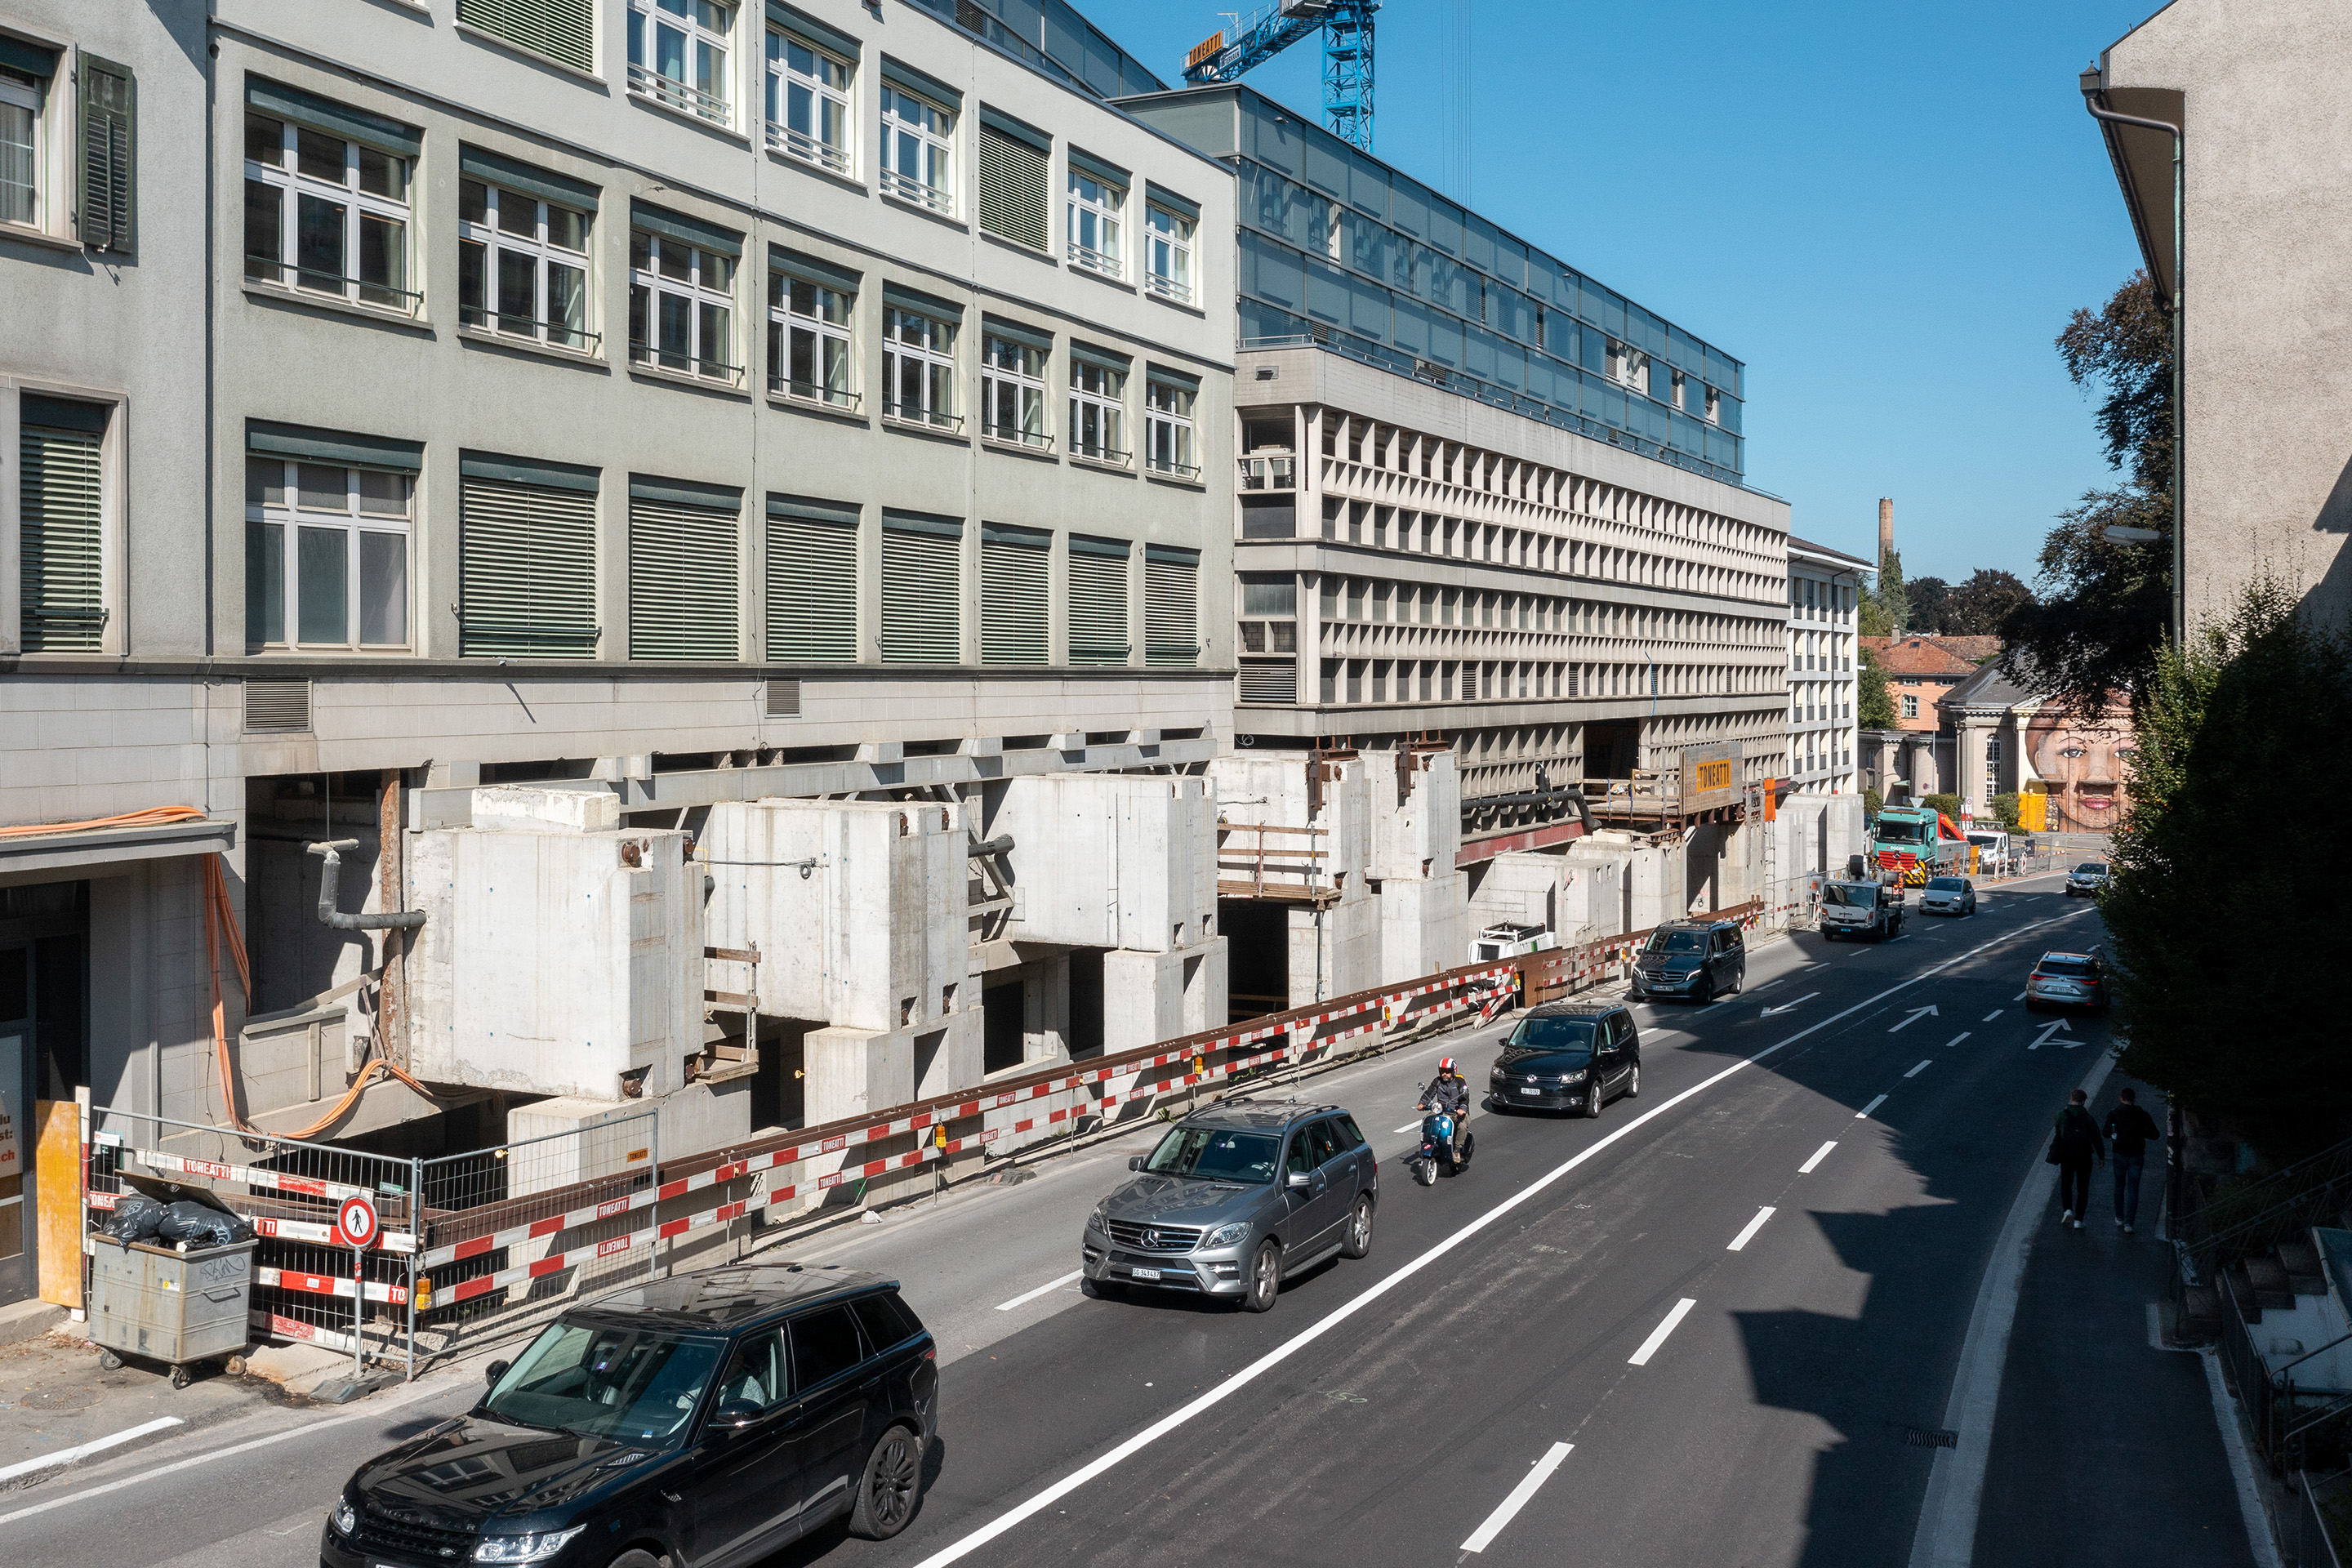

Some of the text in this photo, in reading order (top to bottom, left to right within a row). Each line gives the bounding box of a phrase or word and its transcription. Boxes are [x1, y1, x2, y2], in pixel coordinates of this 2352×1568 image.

[1189, 33, 1221, 65] TONEATTI
[1699, 762, 1729, 789] TONEATTI
[823, 1138, 844, 1151] TONEATTI
[630, 1150, 648, 1160] TONEATTI
[186, 1159, 231, 1178] TONEATTI
[820, 1174, 841, 1187] TONEATTI
[599, 1199, 627, 1217] TONEATTI
[599, 1237, 628, 1255] TONEATTI
